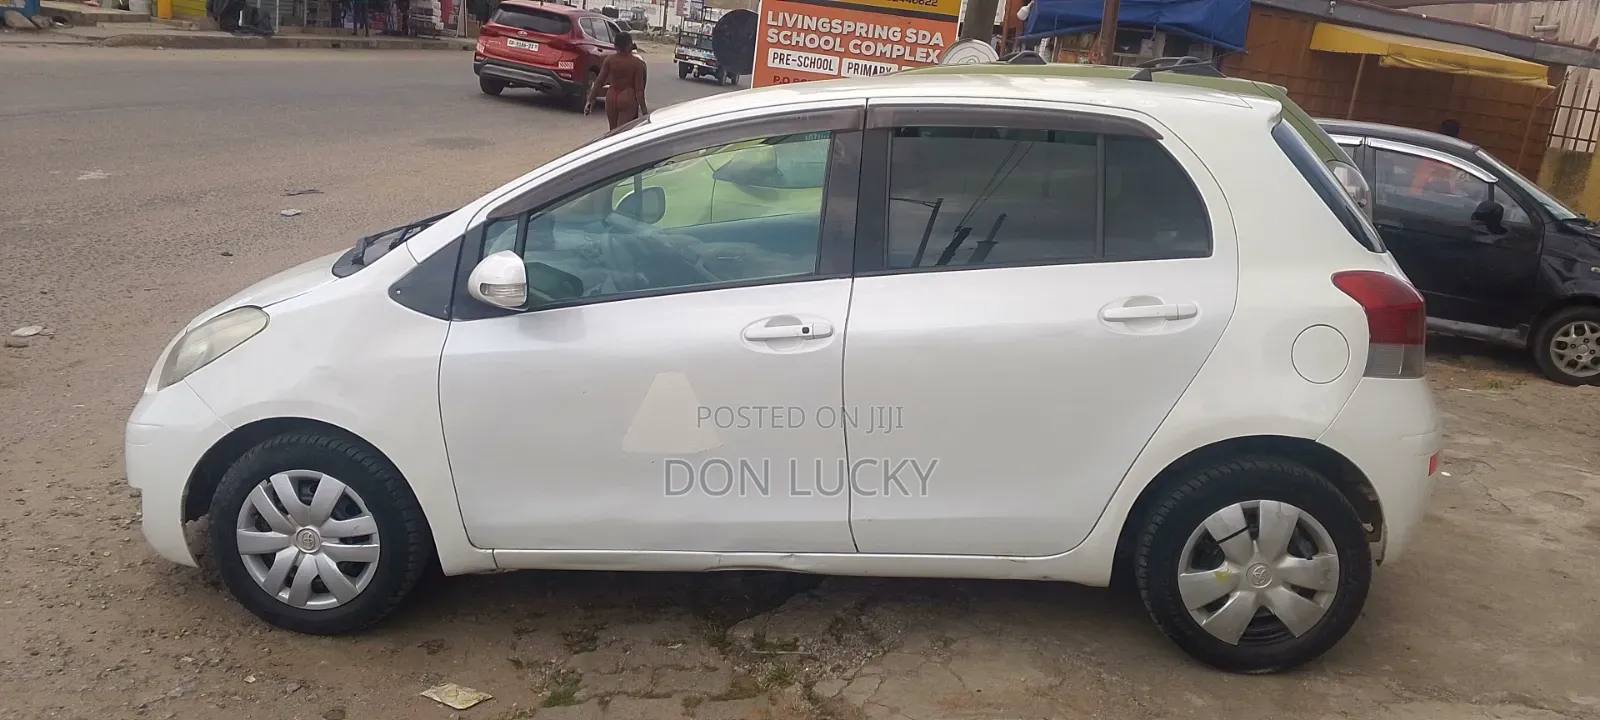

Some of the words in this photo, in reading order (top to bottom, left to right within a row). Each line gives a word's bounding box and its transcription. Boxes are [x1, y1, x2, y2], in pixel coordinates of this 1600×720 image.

[767, 11, 902, 42] LIVINGSPRING
[905, 28, 944, 47] SDA
[767, 29, 845, 53] SCHOOL
[848, 39, 941, 64] COMPLEX
[772, 52, 834, 71] PRE-SCHOOL
